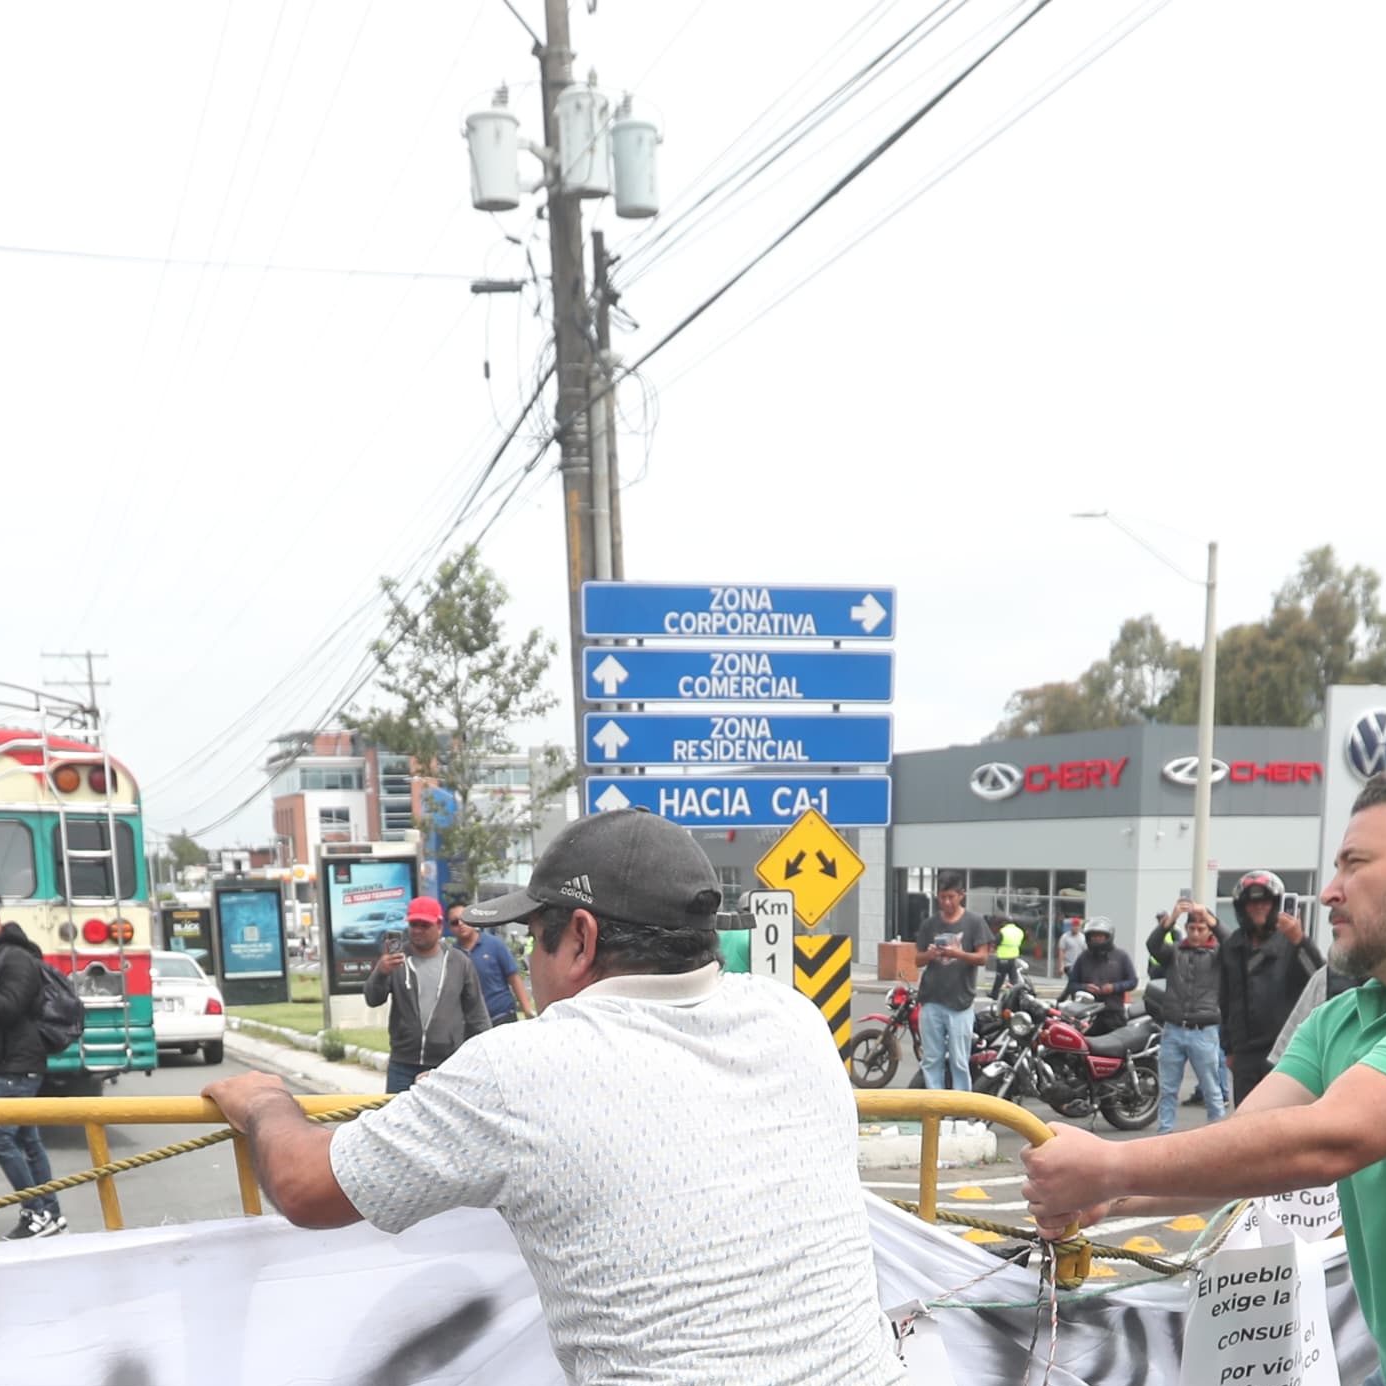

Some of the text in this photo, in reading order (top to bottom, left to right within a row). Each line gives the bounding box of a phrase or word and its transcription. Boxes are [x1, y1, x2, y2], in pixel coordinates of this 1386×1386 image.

[710, 587, 773, 612] ZONA
[664, 611, 816, 635] CORPORATIVA
[710, 653, 772, 676] ZONA
[678, 675, 804, 698] COMERCIAL
[710, 717, 772, 739] ZONA
[673, 739, 809, 762] RESIDENCIAL
[1023, 757, 1129, 792] CHERY
[658, 786, 829, 817] HACIA CA-1
[560, 886, 594, 904] adidas
[755, 899, 788, 916] Km
[765, 924, 779, 946] 0
[766, 953, 776, 974] 1
[1198, 1277, 1212, 1298] El
[1217, 1265, 1293, 1294] pueblo
[1211, 1292, 1266, 1317] exige
[1272, 1289, 1291, 1305] la
[1220, 1364, 1256, 1385] por
